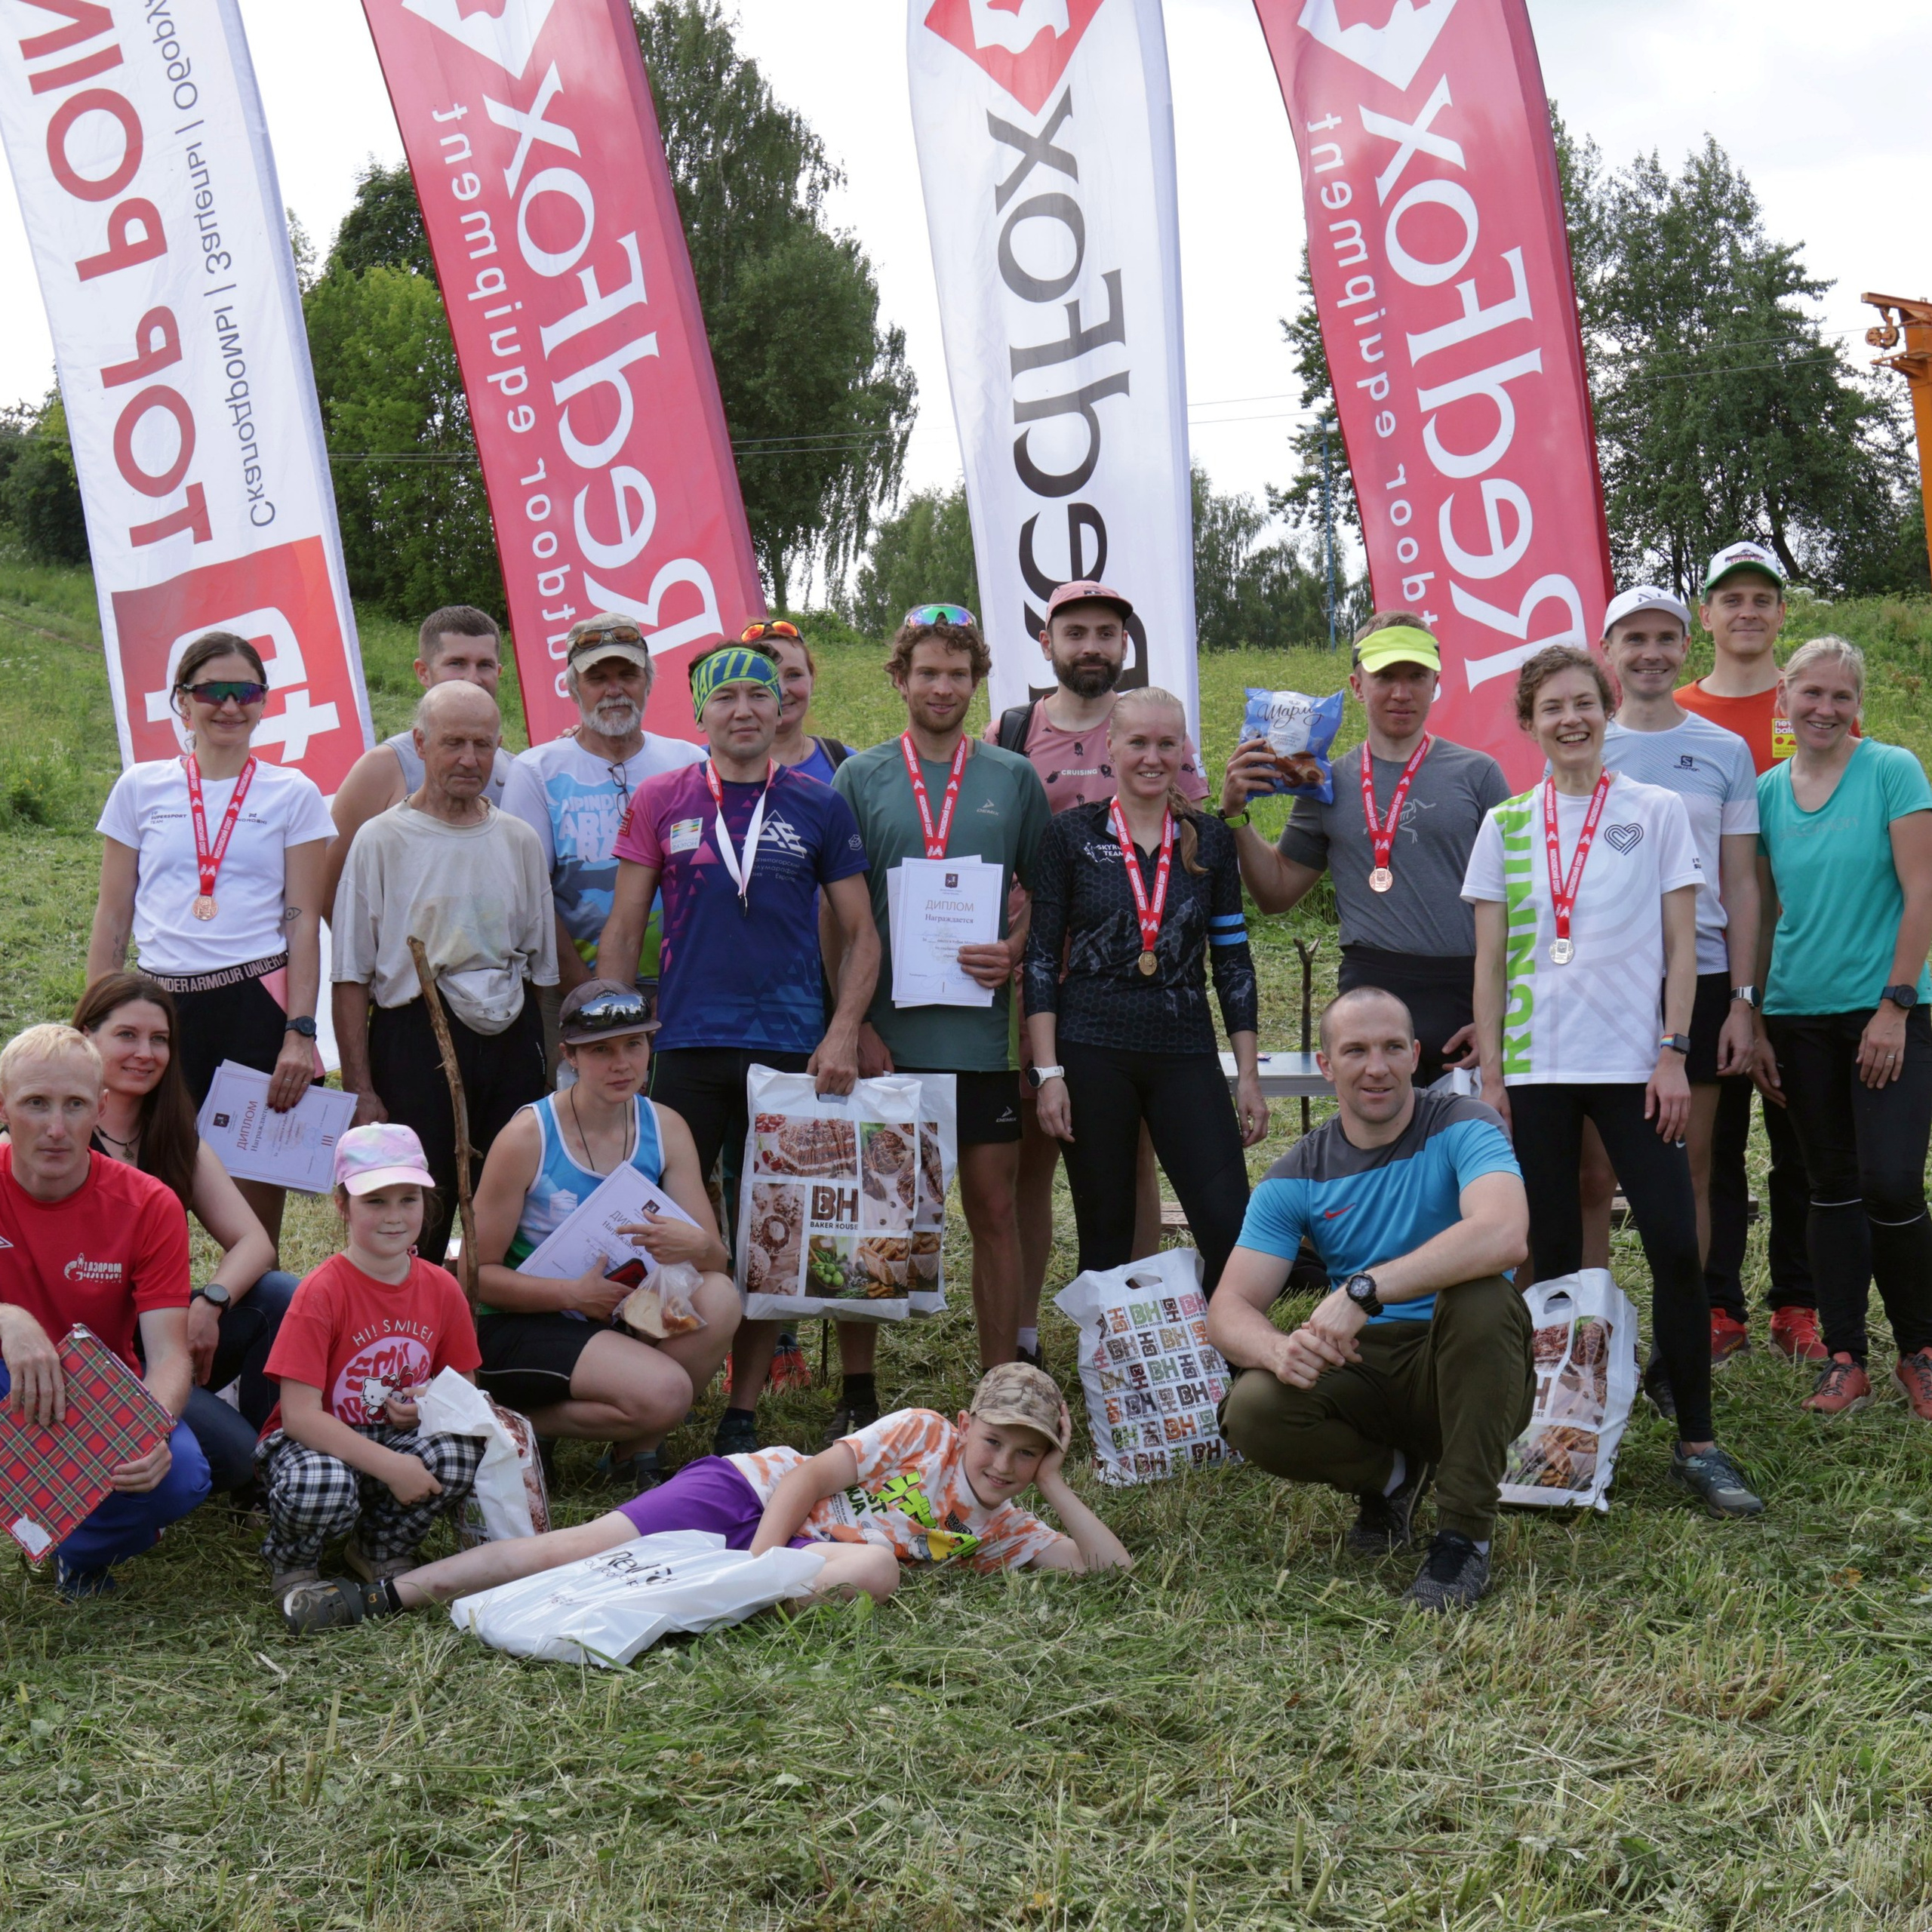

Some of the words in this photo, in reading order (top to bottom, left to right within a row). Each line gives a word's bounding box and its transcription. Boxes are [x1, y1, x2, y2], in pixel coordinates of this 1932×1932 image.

[976, 808, 1000, 817] DEMIX
[924, 900, 974, 912] ДИПЛОМ
[924, 913, 974, 924] Награждается
[1492, 790, 1537, 1075] RUNNIN
[189, 966, 244, 992] ARMOUR
[236, 1100, 259, 1151] ДИПЛОМ
[811, 1185, 859, 1223] BH
[1128, 1300, 1162, 1325] BH
[352, 1324, 378, 1347] HI!
[383, 1319, 434, 1343] SMILE!
[1146, 1357, 1180, 1382] BH
[1176, 1380, 1210, 1407] BH
[1163, 1414, 1197, 1441] BH
